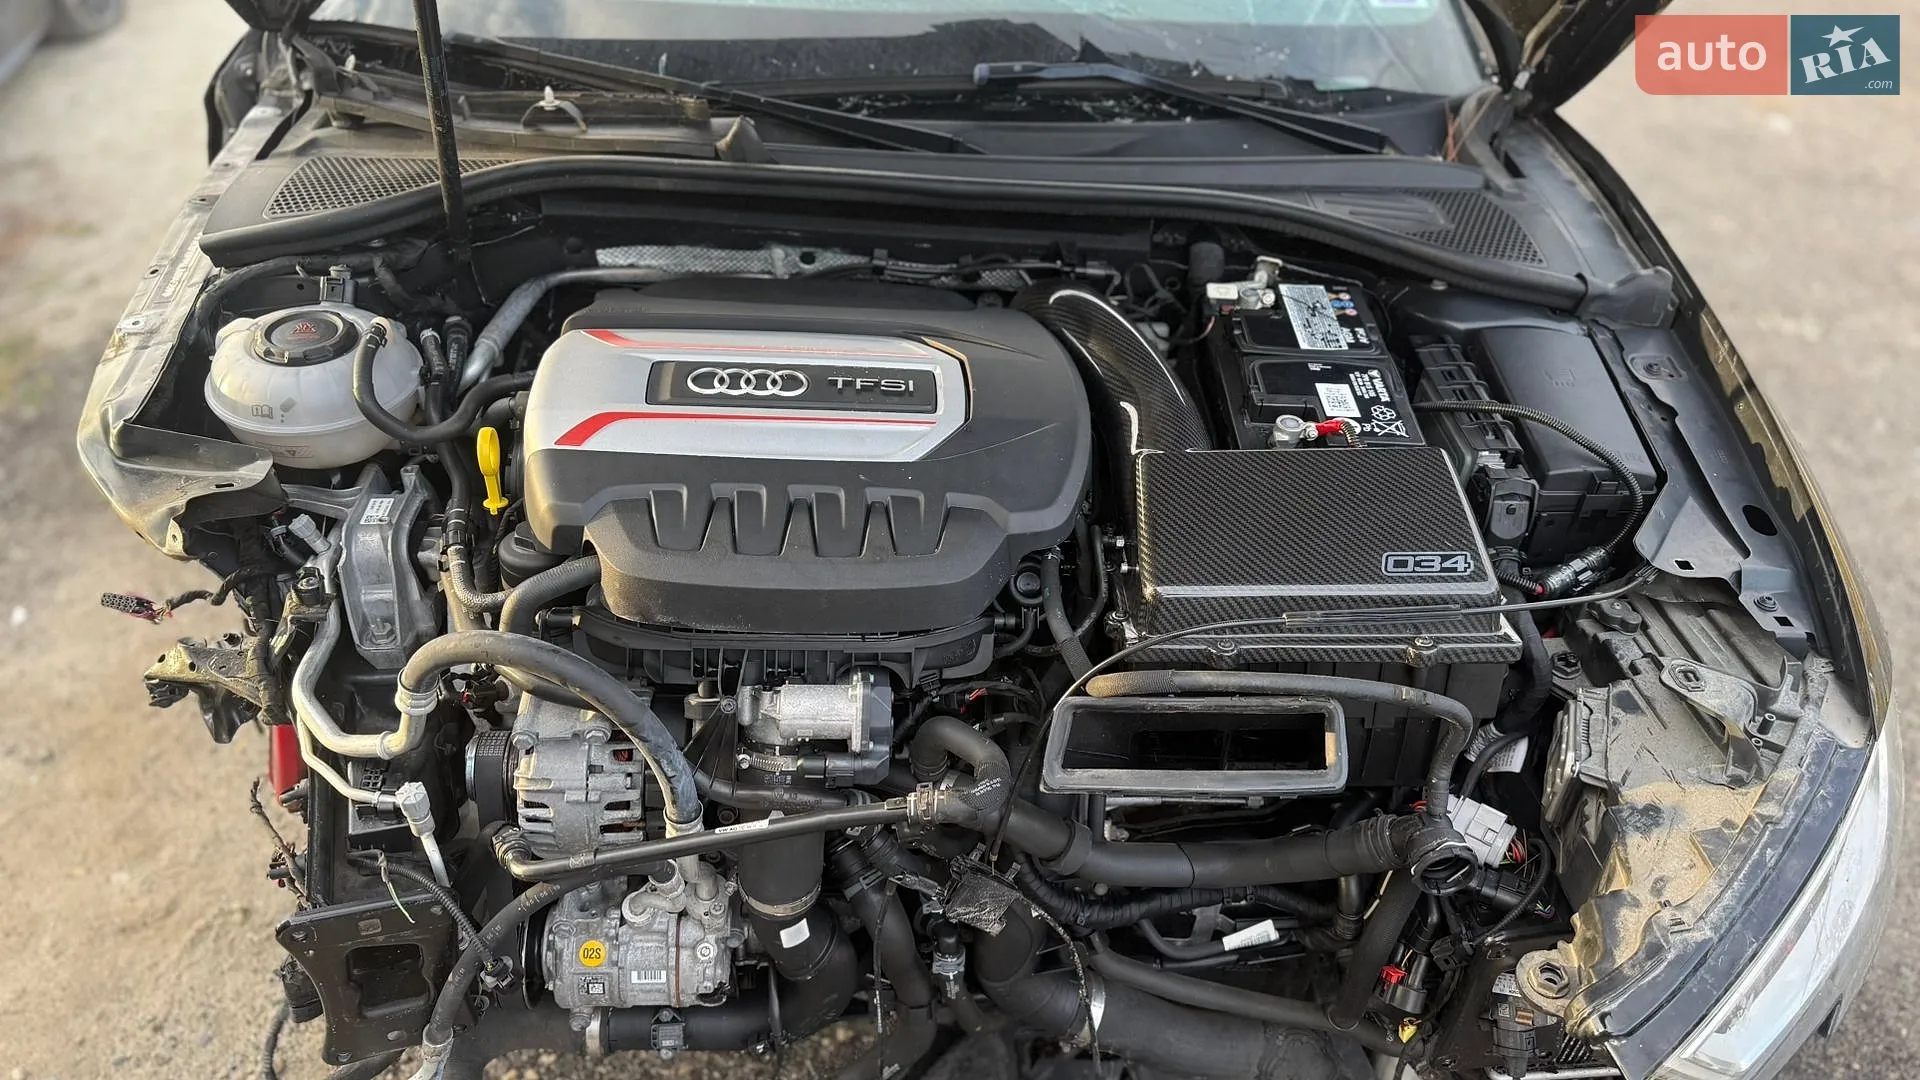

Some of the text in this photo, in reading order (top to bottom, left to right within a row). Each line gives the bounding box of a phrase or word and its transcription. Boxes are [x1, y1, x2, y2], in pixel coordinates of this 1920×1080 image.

[826, 376, 914, 392] TFSI
[1373, 378, 1391, 402] VARTA
[1386, 555, 1469, 573] 034
[583, 947, 602, 960] 02S
